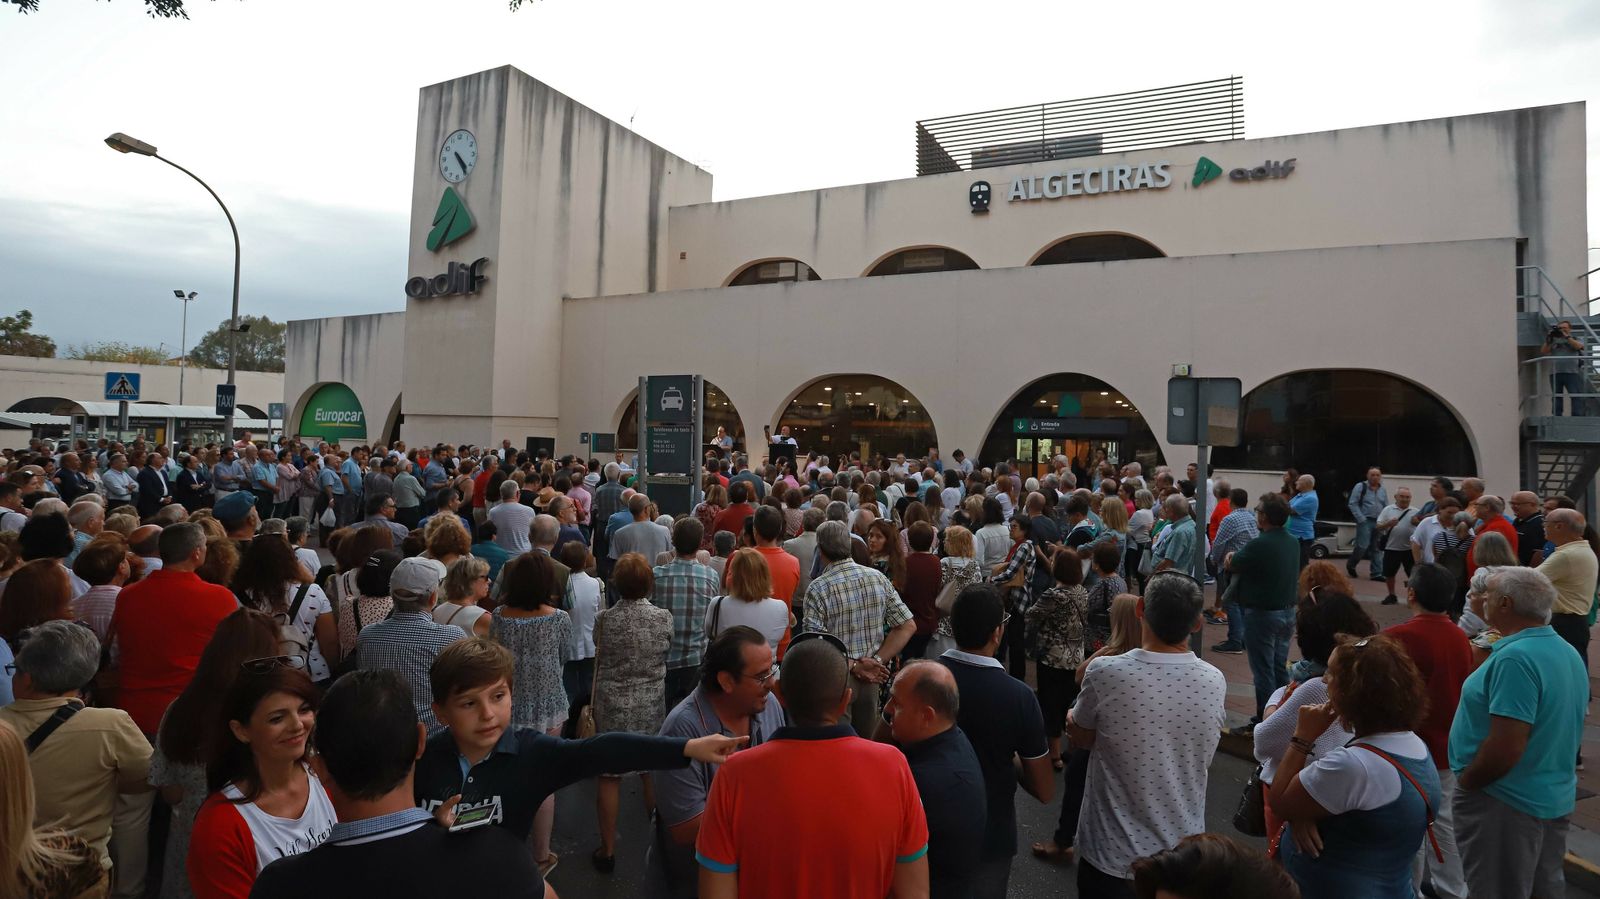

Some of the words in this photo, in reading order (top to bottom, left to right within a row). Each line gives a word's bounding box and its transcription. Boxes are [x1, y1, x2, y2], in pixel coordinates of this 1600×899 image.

[1008, 160, 1172, 201] ALGECIRAS
[1229, 158, 1297, 182] adif
[405, 257, 489, 297] adif
[217, 394, 234, 407] TAXI
[315, 408, 362, 426] Europcar
